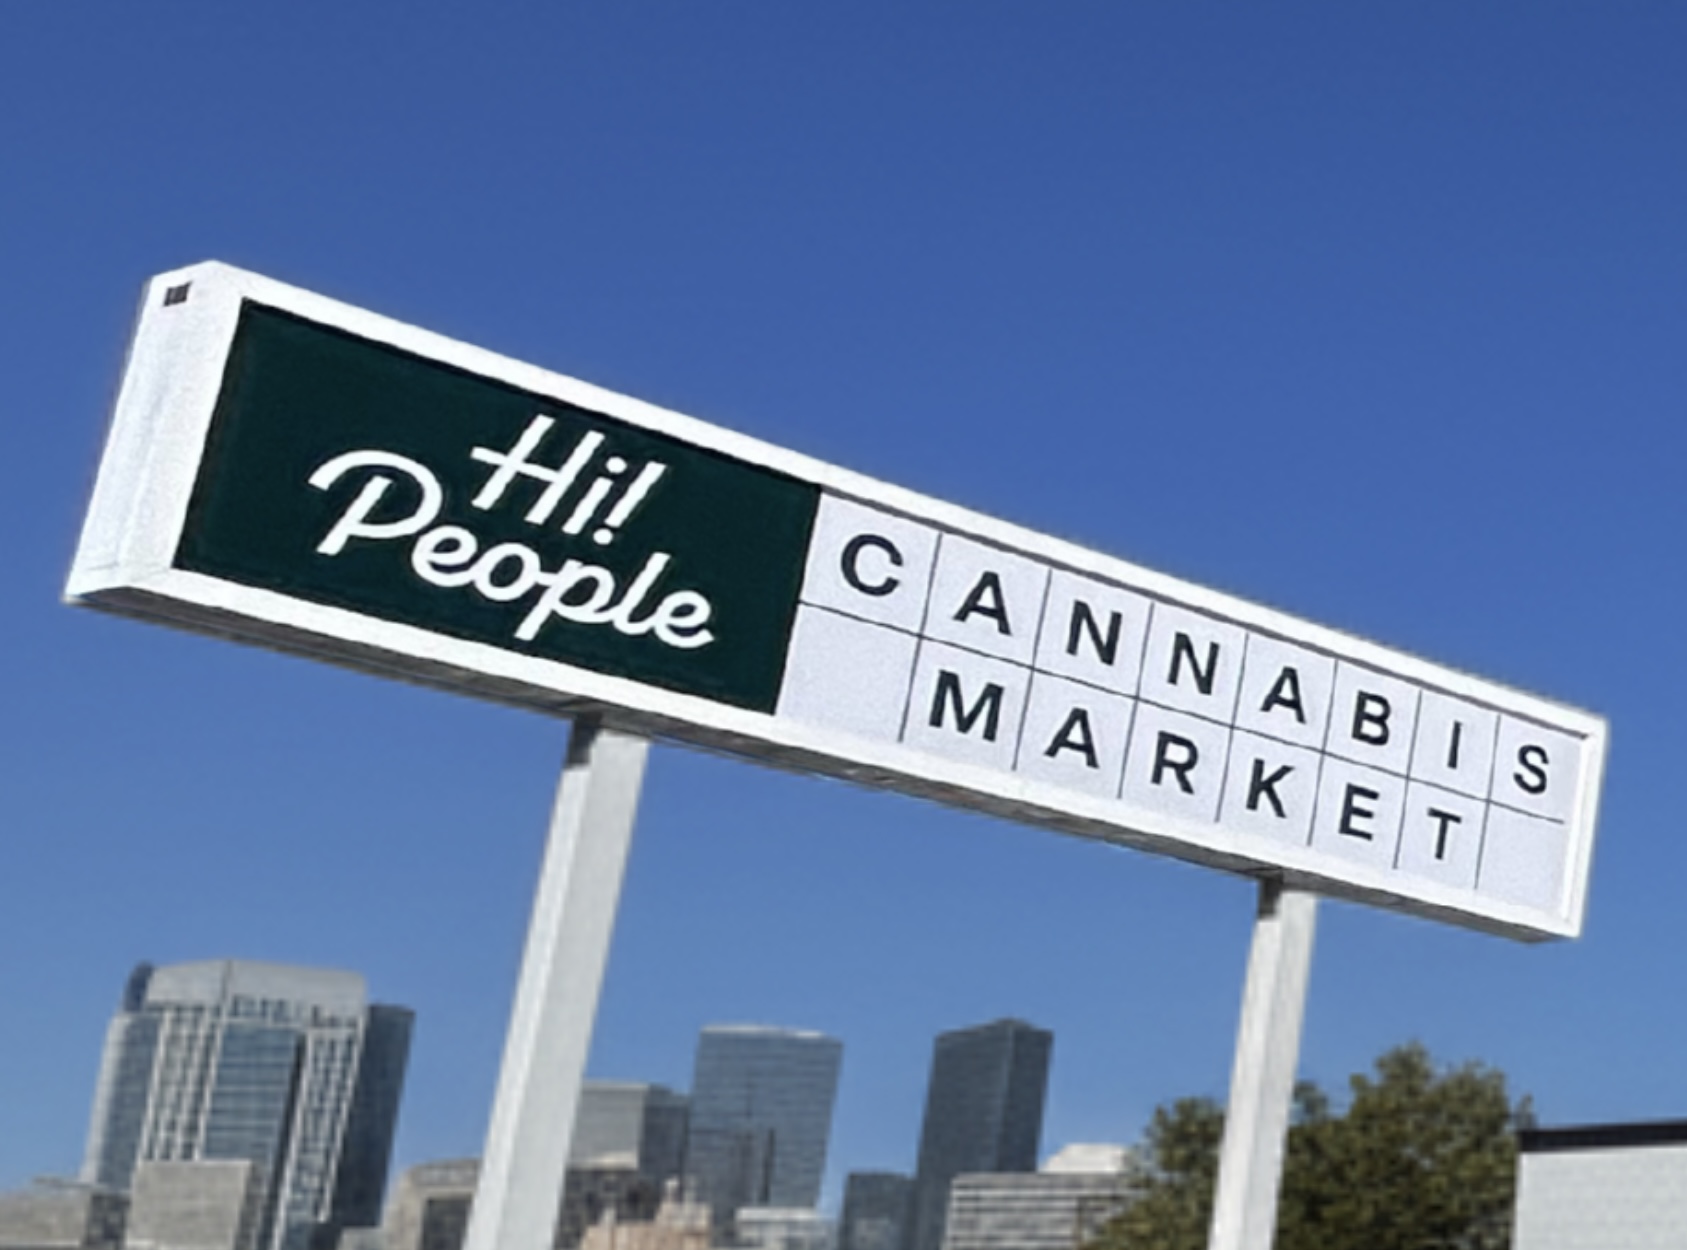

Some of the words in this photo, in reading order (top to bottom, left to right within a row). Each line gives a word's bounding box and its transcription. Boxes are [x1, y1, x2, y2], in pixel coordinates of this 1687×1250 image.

[308, 450, 714, 648] People
[471, 414, 667, 545] Hi!
[840, 534, 1549, 794] CANNABIS
[929, 671, 1461, 861] MARKET
